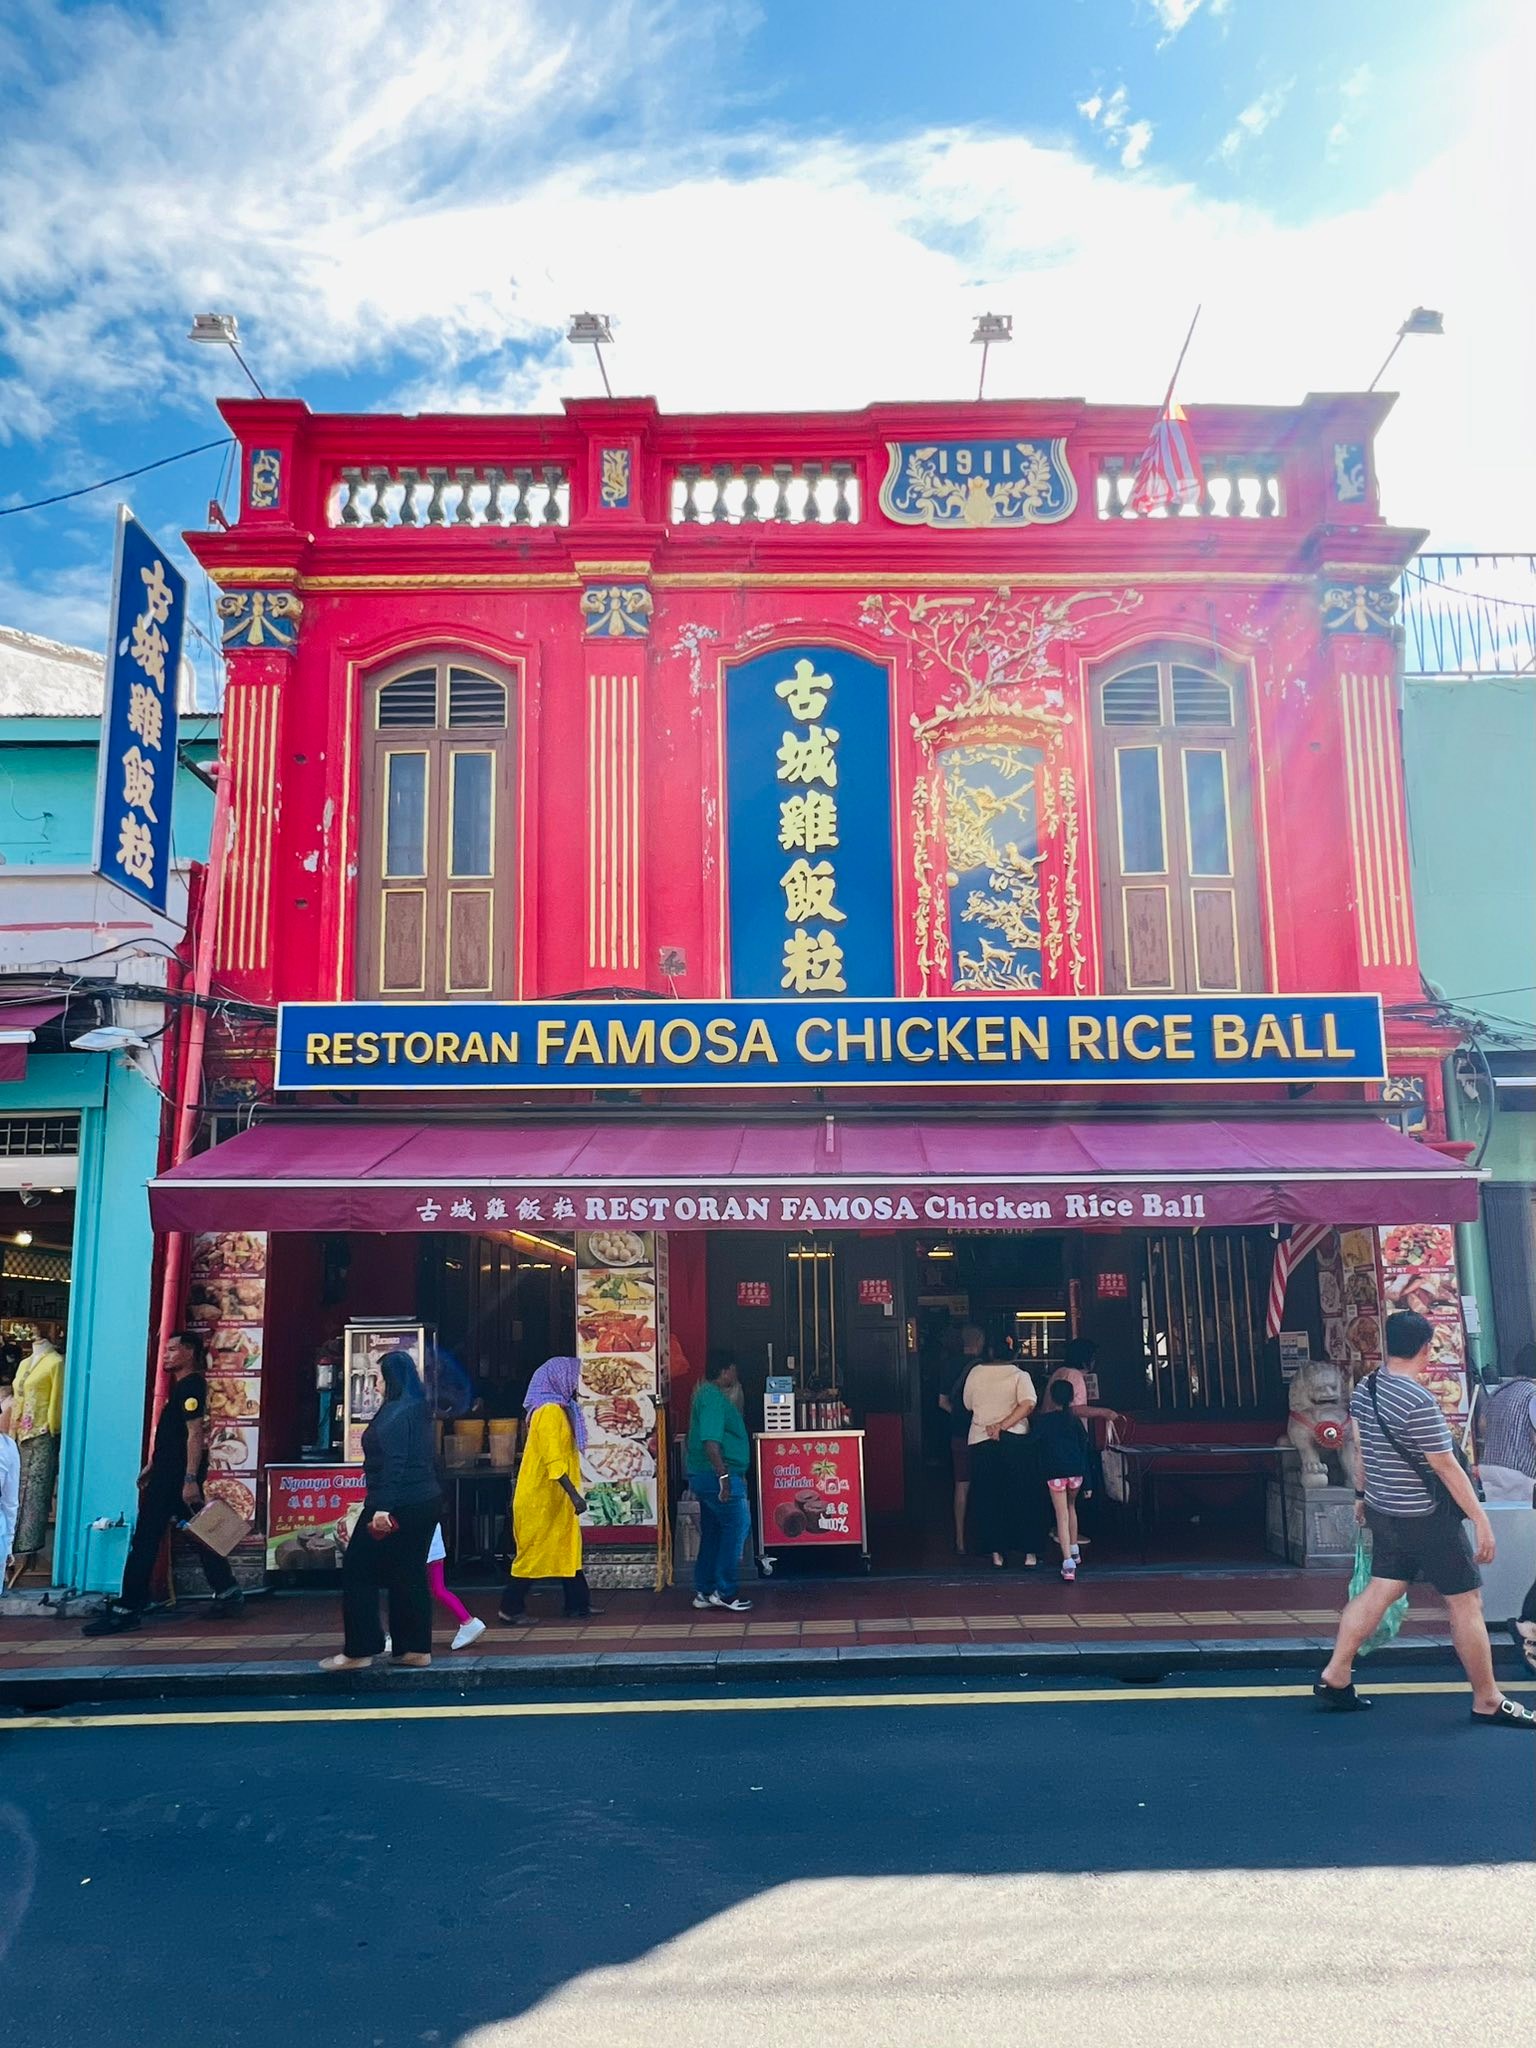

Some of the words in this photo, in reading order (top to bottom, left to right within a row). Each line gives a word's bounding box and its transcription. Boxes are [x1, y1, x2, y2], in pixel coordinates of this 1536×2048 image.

[938, 449, 1011, 474] 1911
[775, 658, 847, 993] 古城雞飯粒
[306, 1031, 519, 1066] RESTORAN
[536, 1018, 778, 1066] FAMOSA
[796, 1016, 1049, 1062] CHICKEN
[1068, 1014, 1195, 1061] RICE
[1212, 1013, 1355, 1060] BALL
[585, 1197, 769, 1222] RESTORAN
[780, 1197, 919, 1222] FAMOSA
[924, 1195, 1052, 1221] Chicken
[1065, 1194, 1133, 1219] Rice
[1142, 1193, 1206, 1219] Ball
[280, 1475, 331, 1492] Nyonya
[333, 1473, 366, 1488] Cend
[773, 1464, 801, 1476] Gula
[774, 1476, 814, 1489] Melaka
